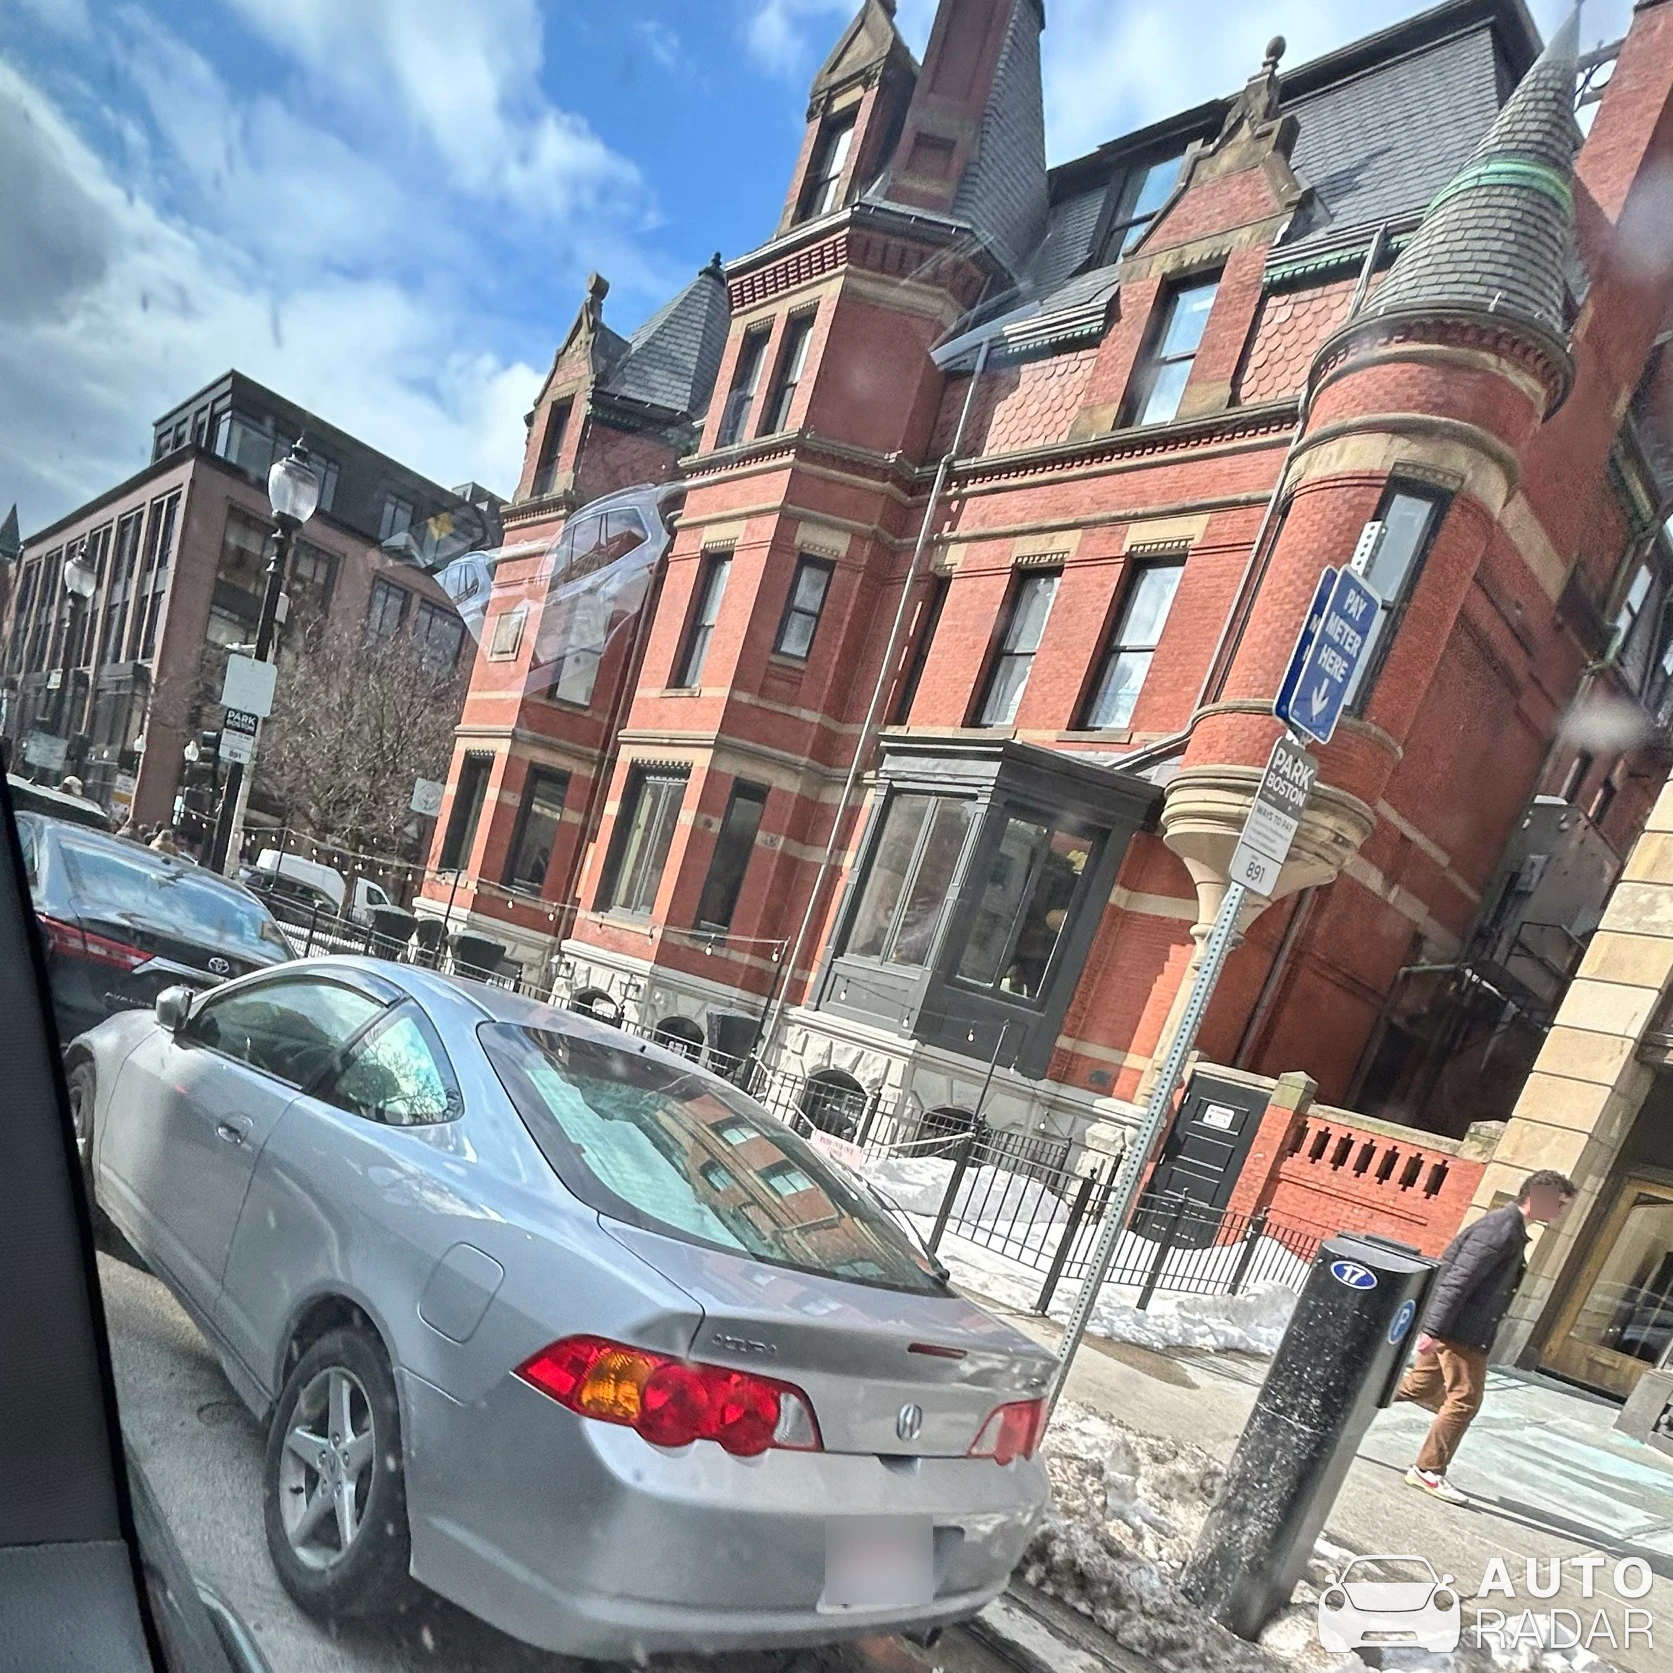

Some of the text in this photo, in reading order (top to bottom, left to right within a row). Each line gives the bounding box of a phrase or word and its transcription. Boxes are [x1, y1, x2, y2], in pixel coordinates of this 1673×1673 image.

[1343, 588, 1368, 621] PAY
[1325, 611, 1363, 658] METER
[1317, 643, 1349, 683] HERE
[228, 710, 256, 725] PARK
[1272, 747, 1315, 791] PARK
[1265, 771, 1306, 807] BOSTON
[1245, 861, 1266, 883] 891
[1343, 1264, 1367, 1284] 17
[1393, 1308, 1411, 1336] P
